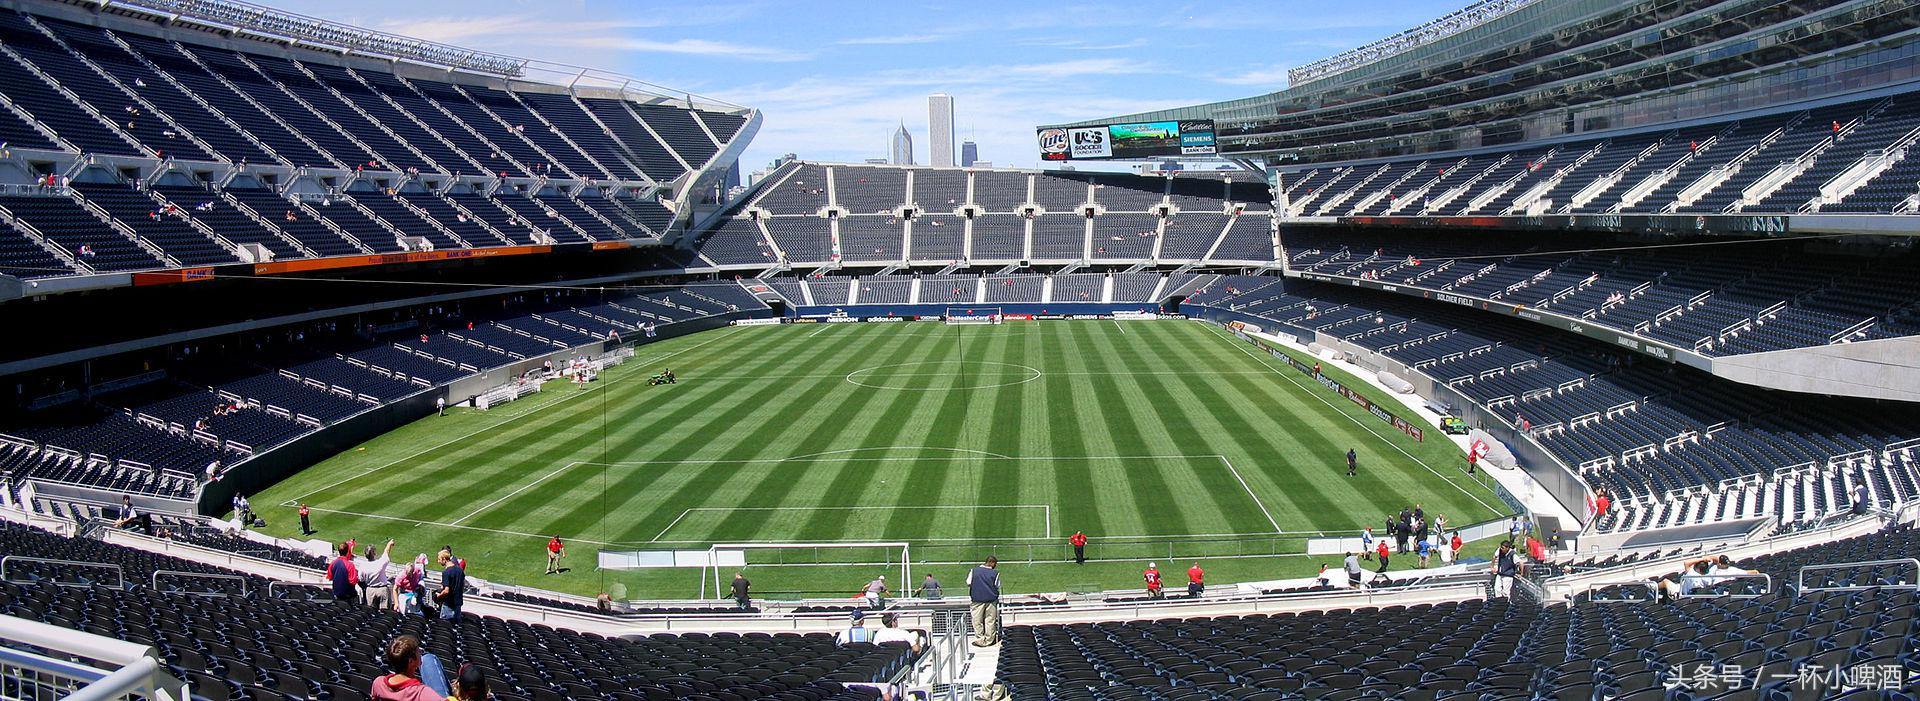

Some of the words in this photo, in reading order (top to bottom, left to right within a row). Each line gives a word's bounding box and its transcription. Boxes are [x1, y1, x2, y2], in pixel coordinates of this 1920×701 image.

[1180, 122, 1212, 131] Cadillac
[1043, 134, 1066, 148] Lite
[1437, 293, 1458, 304] SOLDIER
[1458, 297, 1474, 306] FIELD
[1370, 404, 1392, 424] adidas.com
